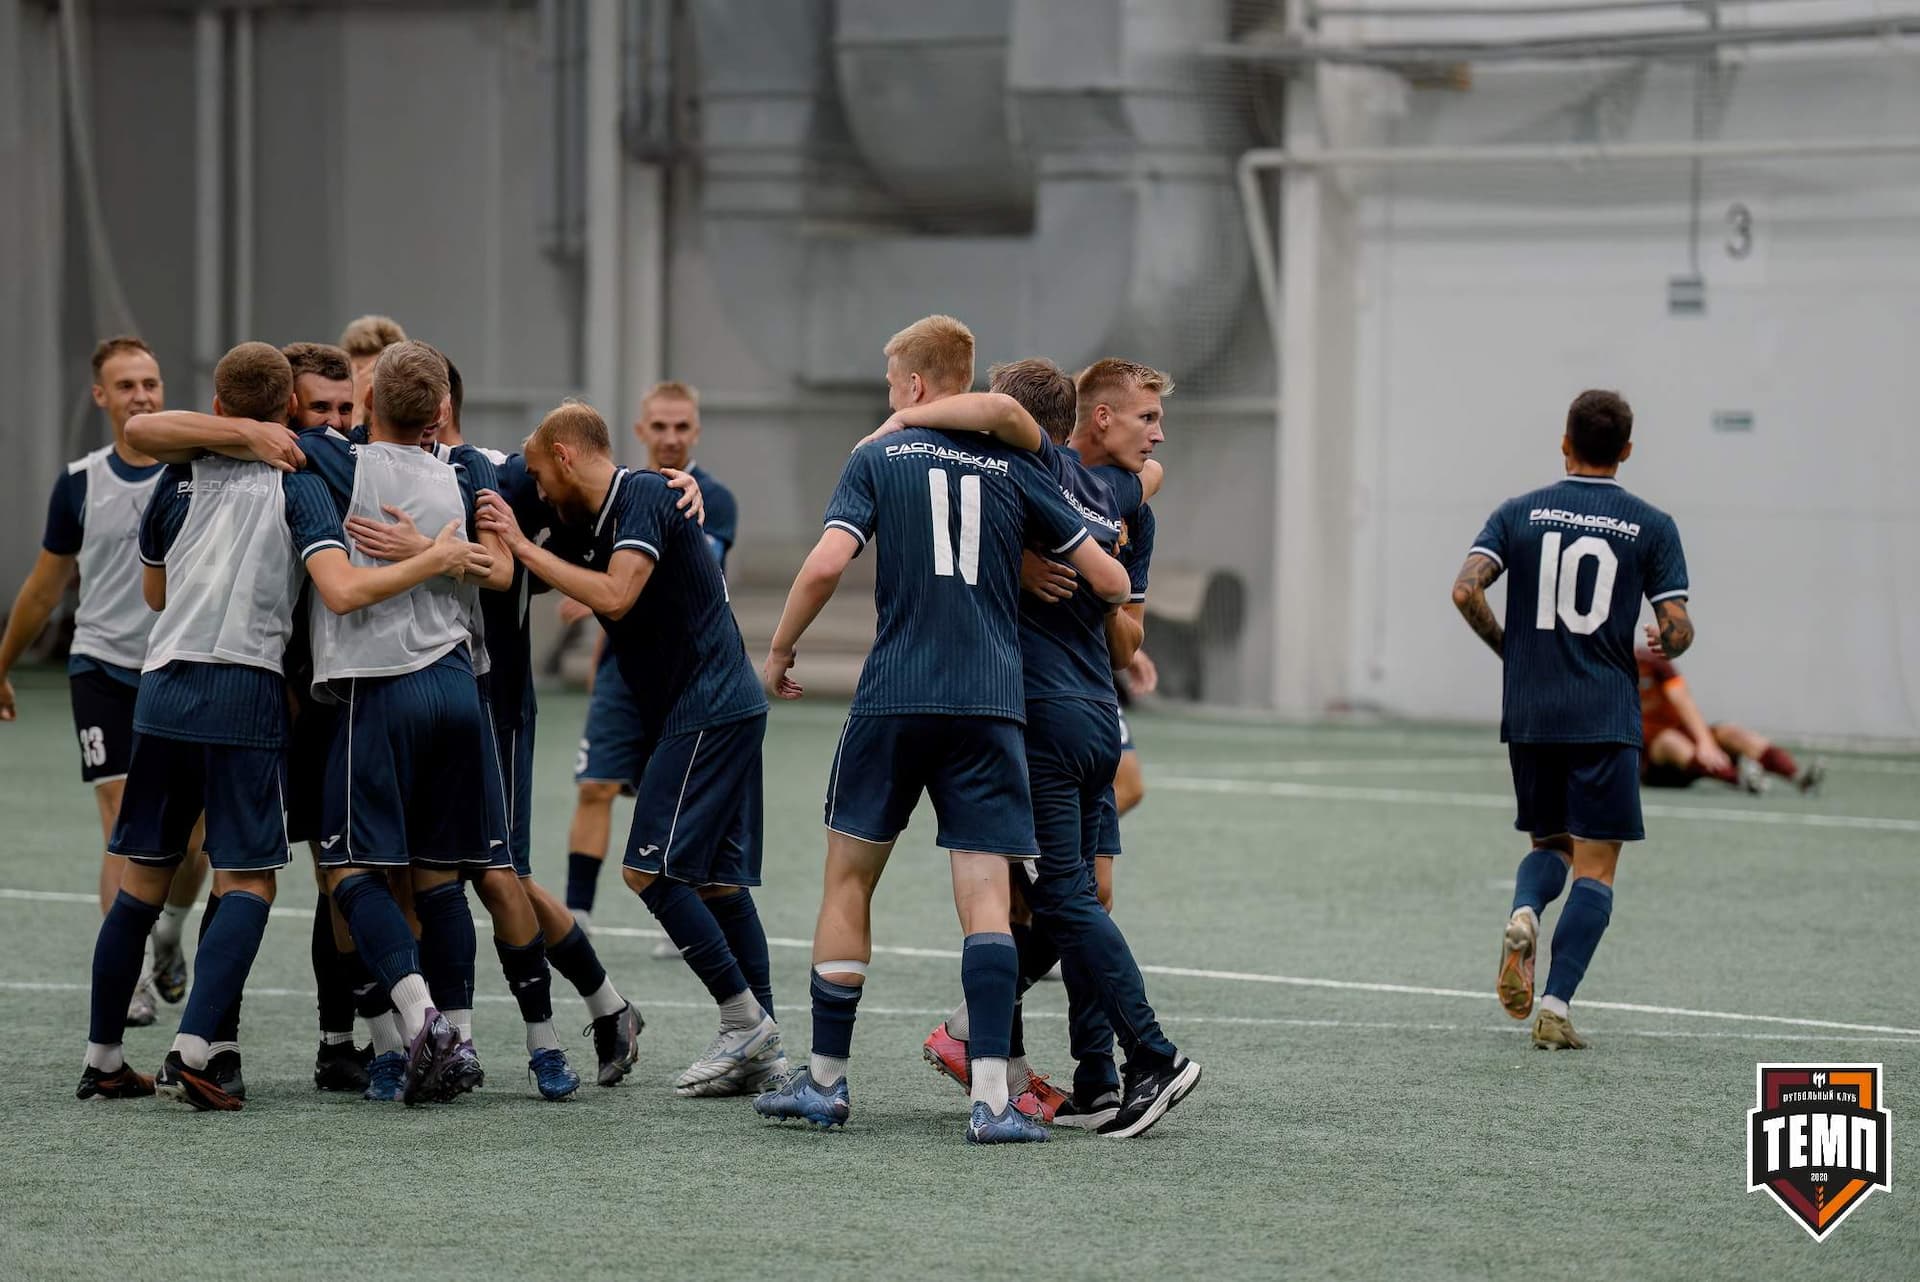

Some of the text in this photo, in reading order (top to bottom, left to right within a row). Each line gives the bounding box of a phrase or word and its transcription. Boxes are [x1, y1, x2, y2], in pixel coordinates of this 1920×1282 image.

[1725, 202, 1753, 260] 3
[885, 442, 1009, 473] РАСПАДСКАЯ
[928, 467, 981, 586] 11
[1530, 508, 1640, 537] РАСПАДСКАЯ
[1536, 531, 1619, 636] 10
